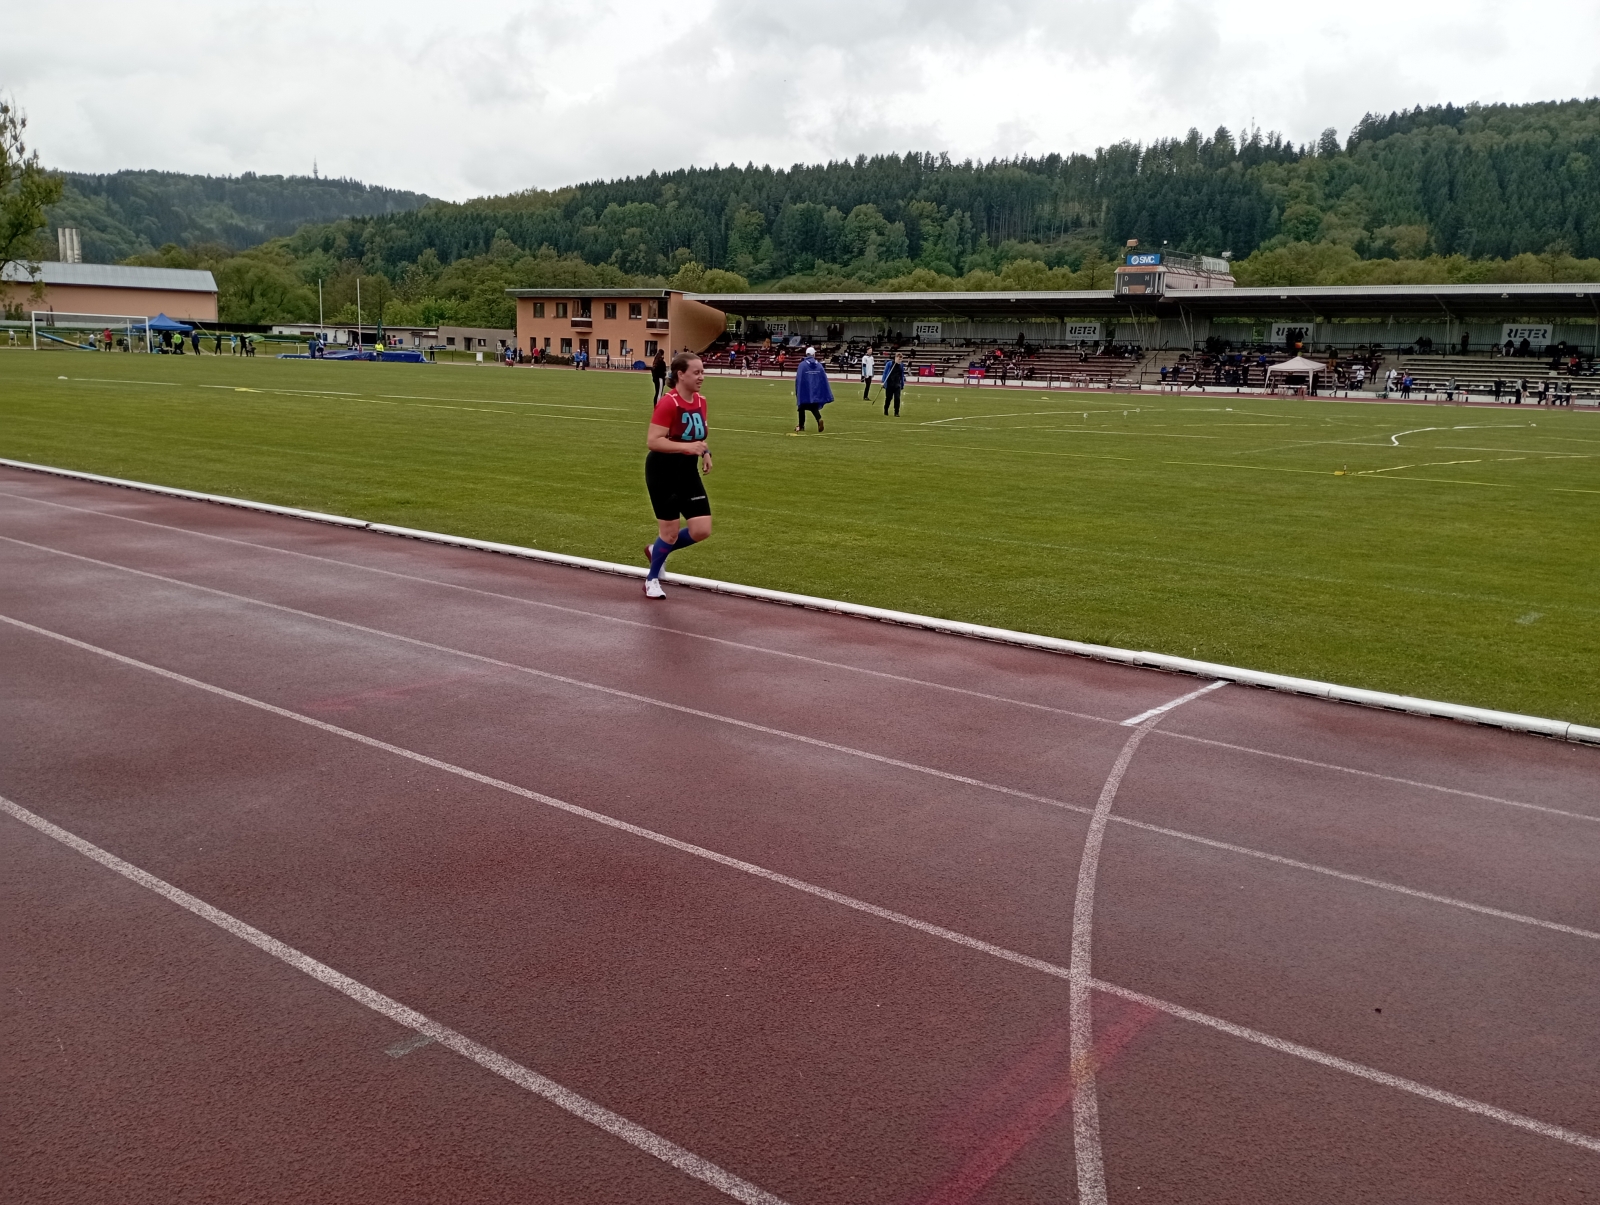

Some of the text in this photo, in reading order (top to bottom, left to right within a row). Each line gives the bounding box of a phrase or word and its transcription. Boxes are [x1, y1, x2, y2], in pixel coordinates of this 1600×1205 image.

[1139, 255, 1155, 264] SMC
[767, 323, 787, 331] RIETER
[916, 326, 938, 334] RIETER
[1069, 326, 1096, 334] RIETER
[1276, 327, 1309, 336] RITR
[1507, 328, 1548, 338] RIETER
[681, 412, 705, 441] 28
